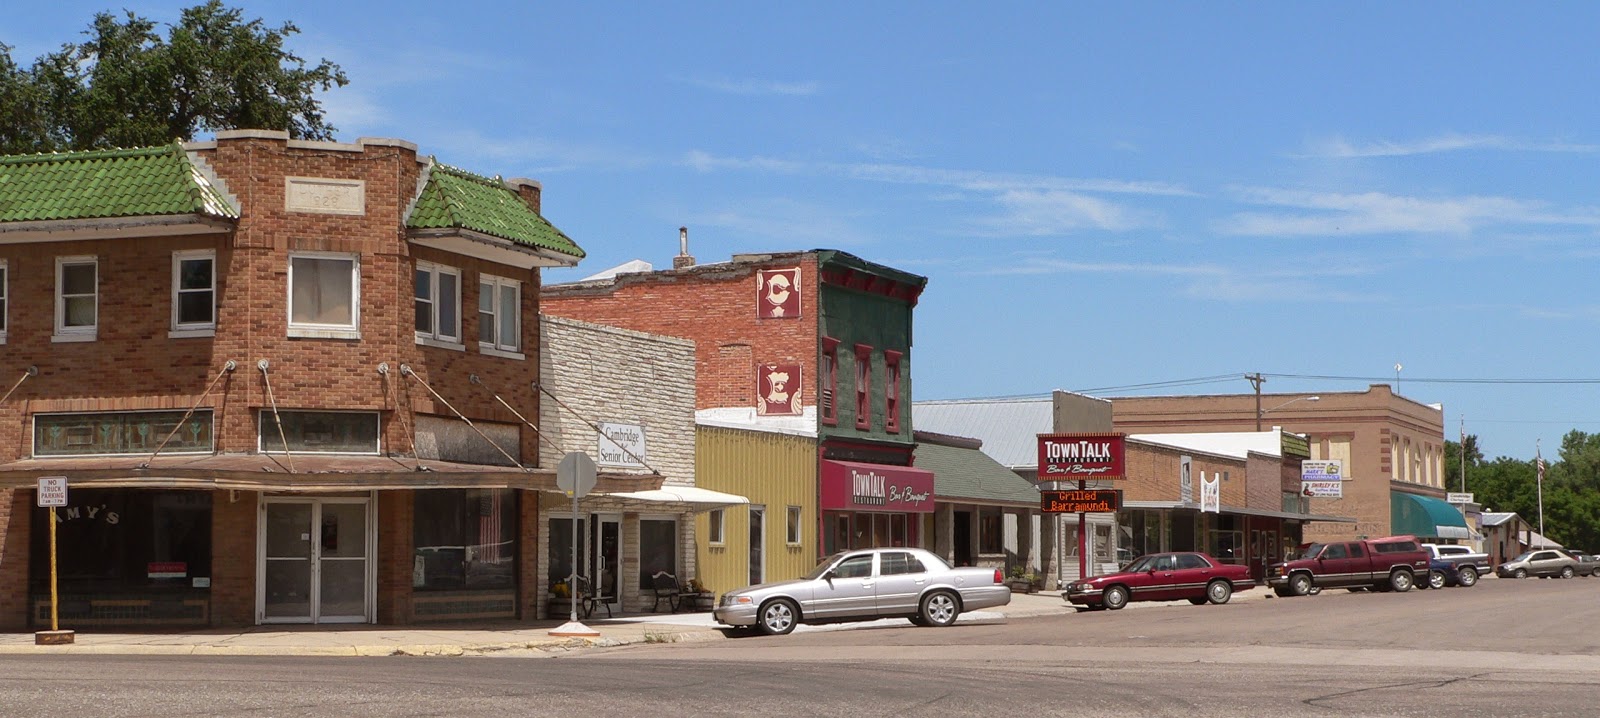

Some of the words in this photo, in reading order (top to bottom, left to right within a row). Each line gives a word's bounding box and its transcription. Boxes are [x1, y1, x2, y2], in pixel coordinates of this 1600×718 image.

[605, 426, 640, 447] Cambridge
[600, 448, 621, 463] Senior
[622, 450, 644, 464] Center
[1059, 490, 1096, 501] Grilled
[1051, 500, 1110, 511] Barramundi
